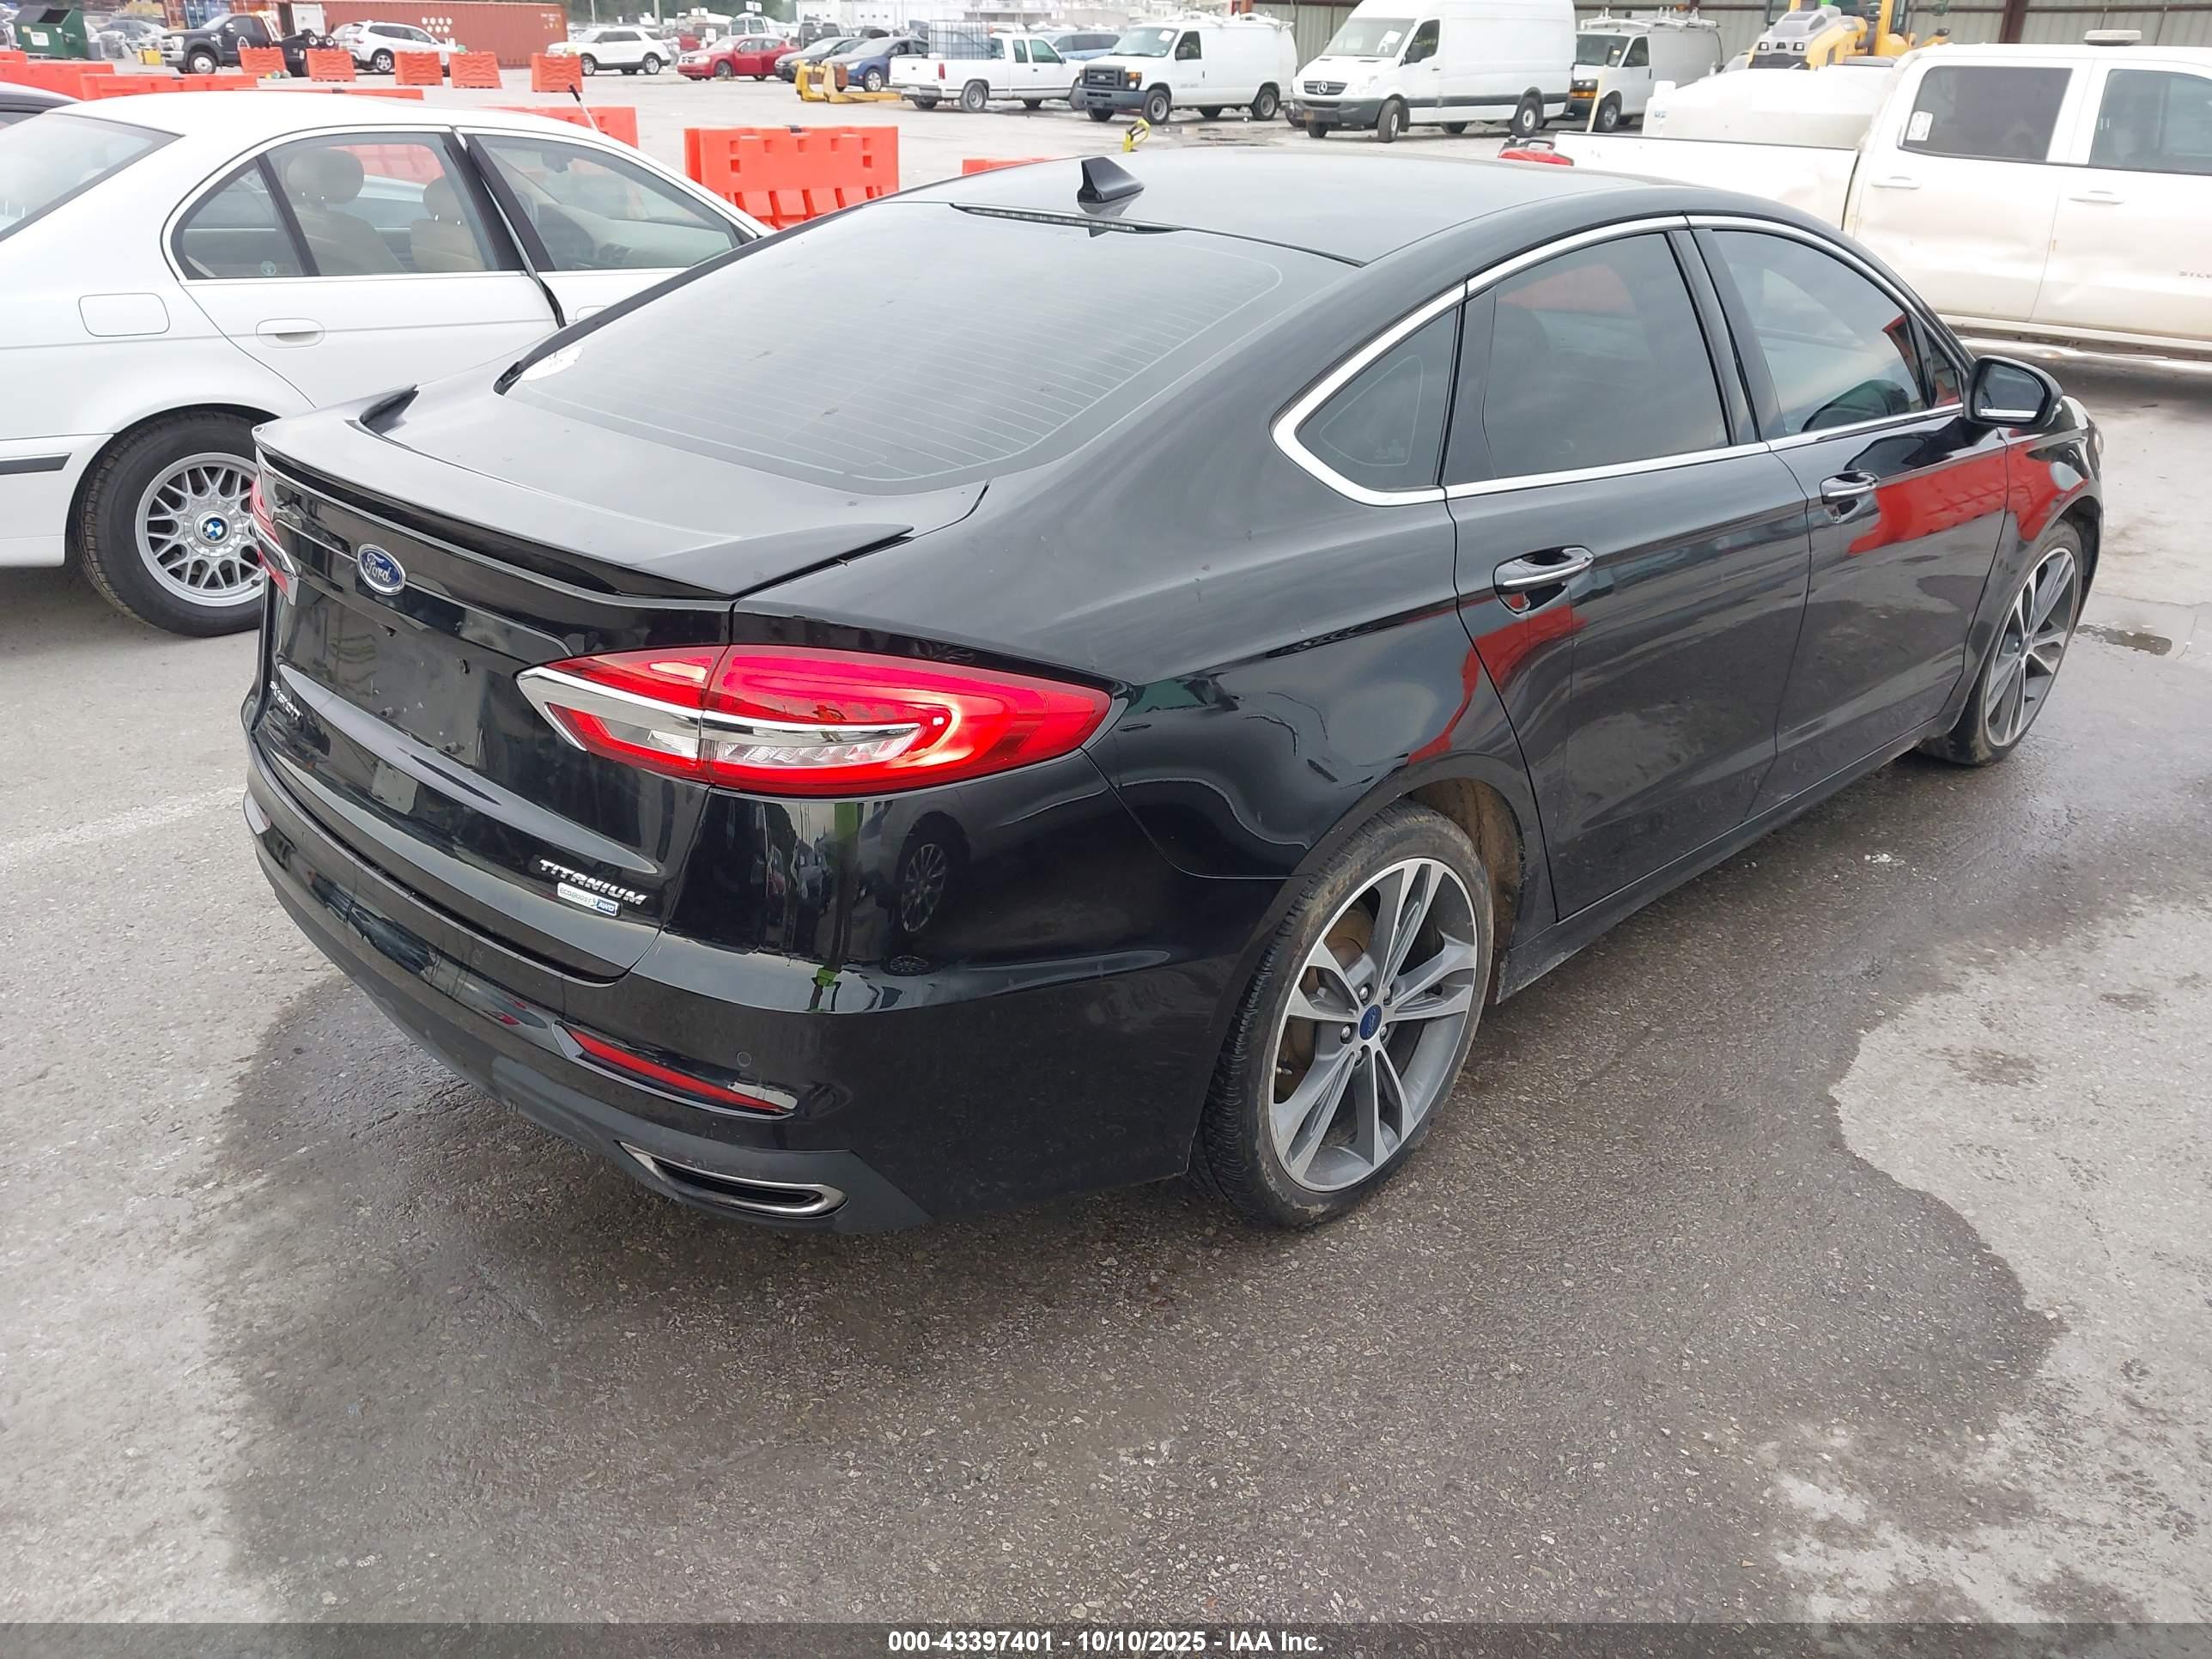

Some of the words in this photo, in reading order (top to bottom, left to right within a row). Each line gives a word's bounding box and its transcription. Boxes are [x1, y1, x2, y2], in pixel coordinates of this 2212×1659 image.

[364, 552, 392, 583] Ford
[539, 859, 647, 906] TITANIUM
[597, 900, 617, 913] AWD
